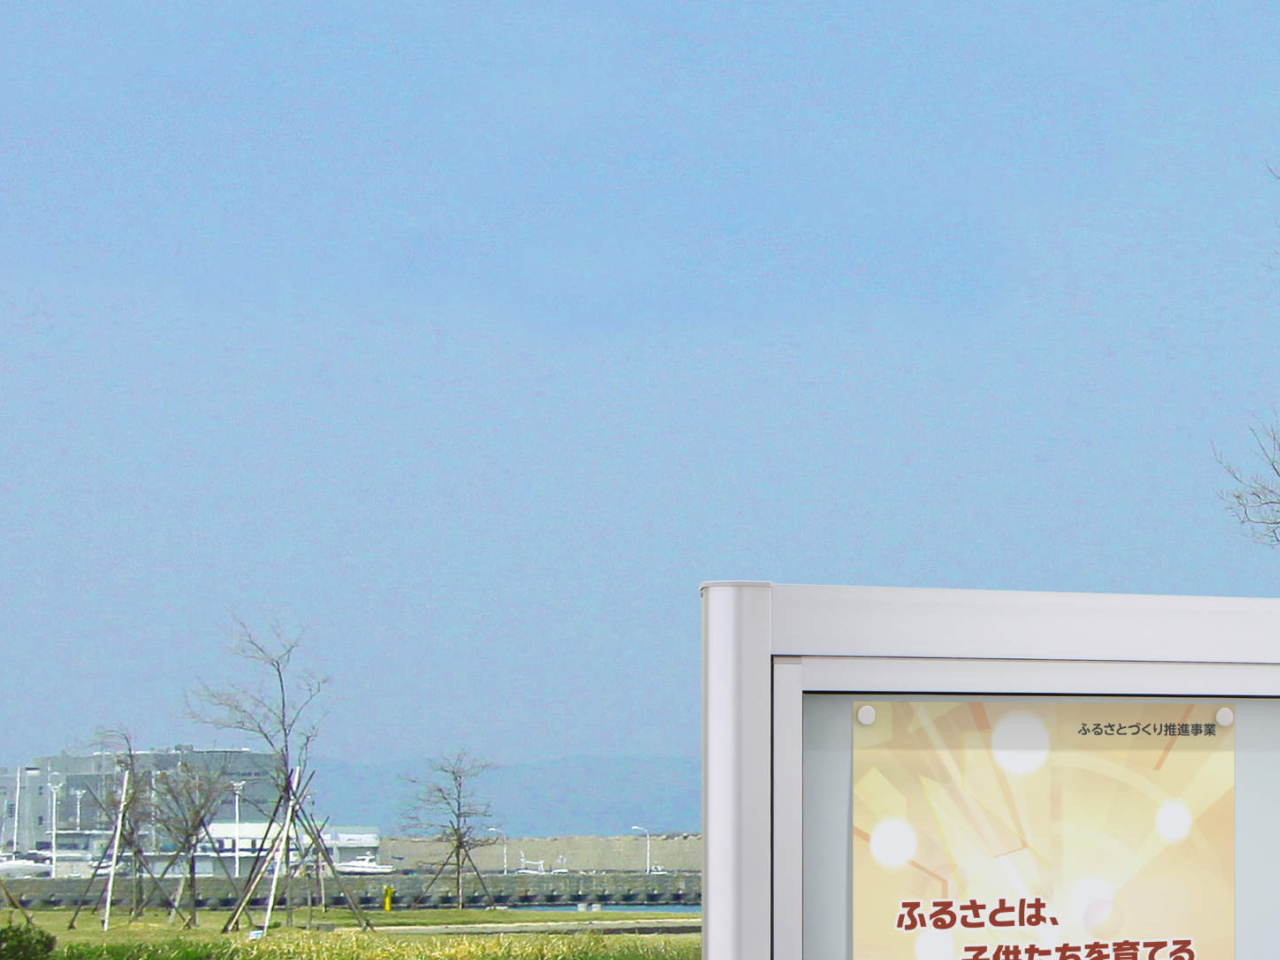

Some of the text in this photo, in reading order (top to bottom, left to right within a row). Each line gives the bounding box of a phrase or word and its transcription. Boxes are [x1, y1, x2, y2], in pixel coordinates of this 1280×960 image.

[1077, 722, 1217, 737] ふるさとづくり推進事業
[896, 898, 1059, 931] ふるさとは、
